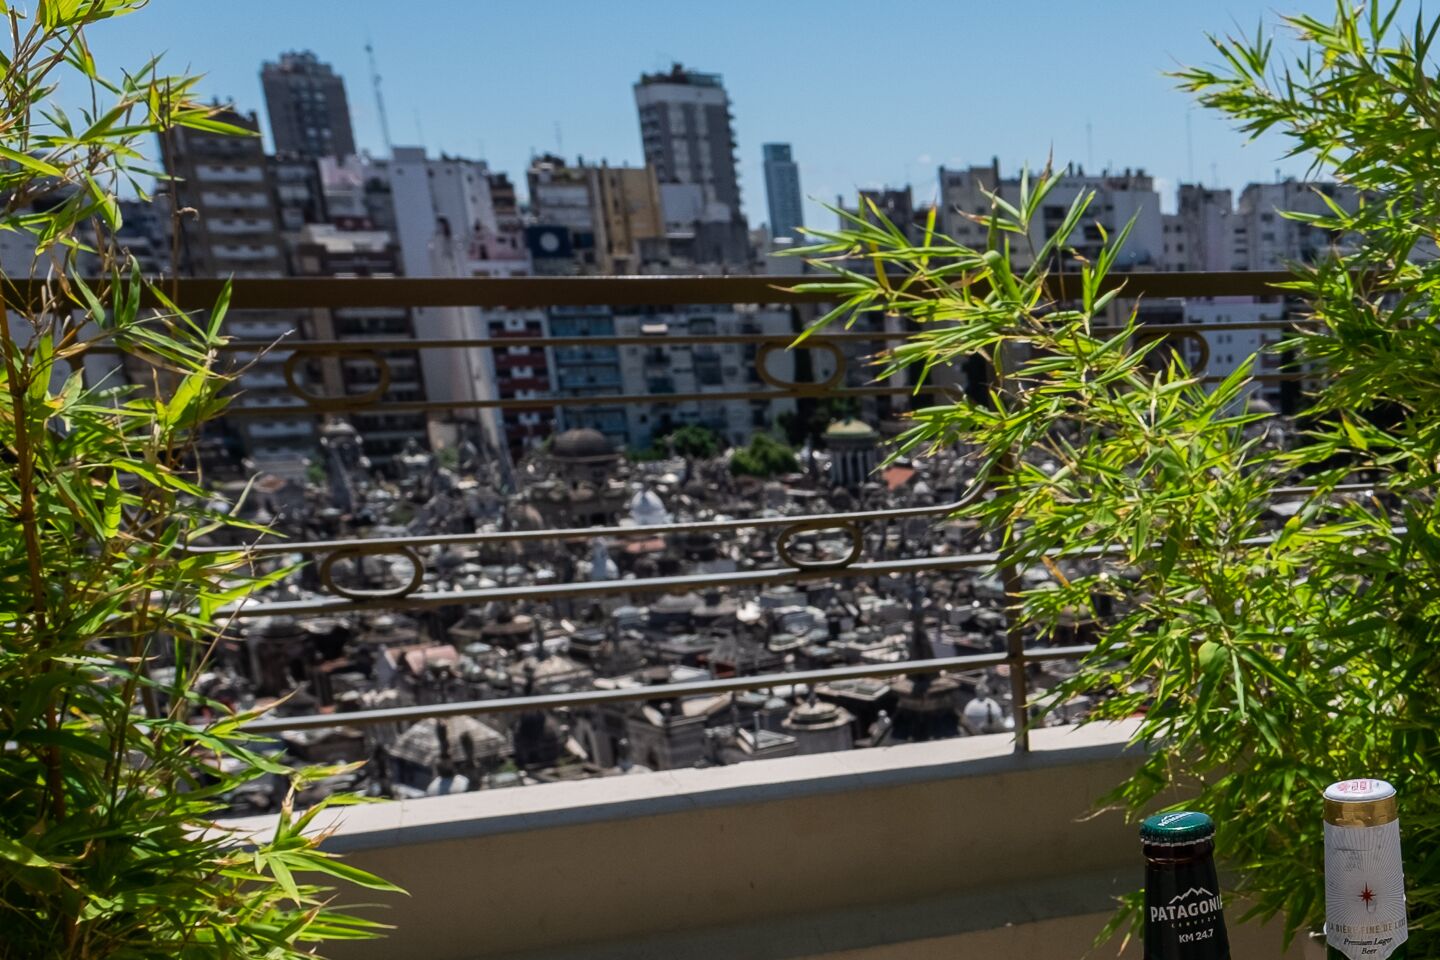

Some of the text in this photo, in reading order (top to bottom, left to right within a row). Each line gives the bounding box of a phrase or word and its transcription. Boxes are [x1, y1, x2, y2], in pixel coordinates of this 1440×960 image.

[1179, 928, 1214, 943] KM 24.7
[1343, 937, 1392, 946] Premium Lager
[1361, 947, 1377, 955] Beer
